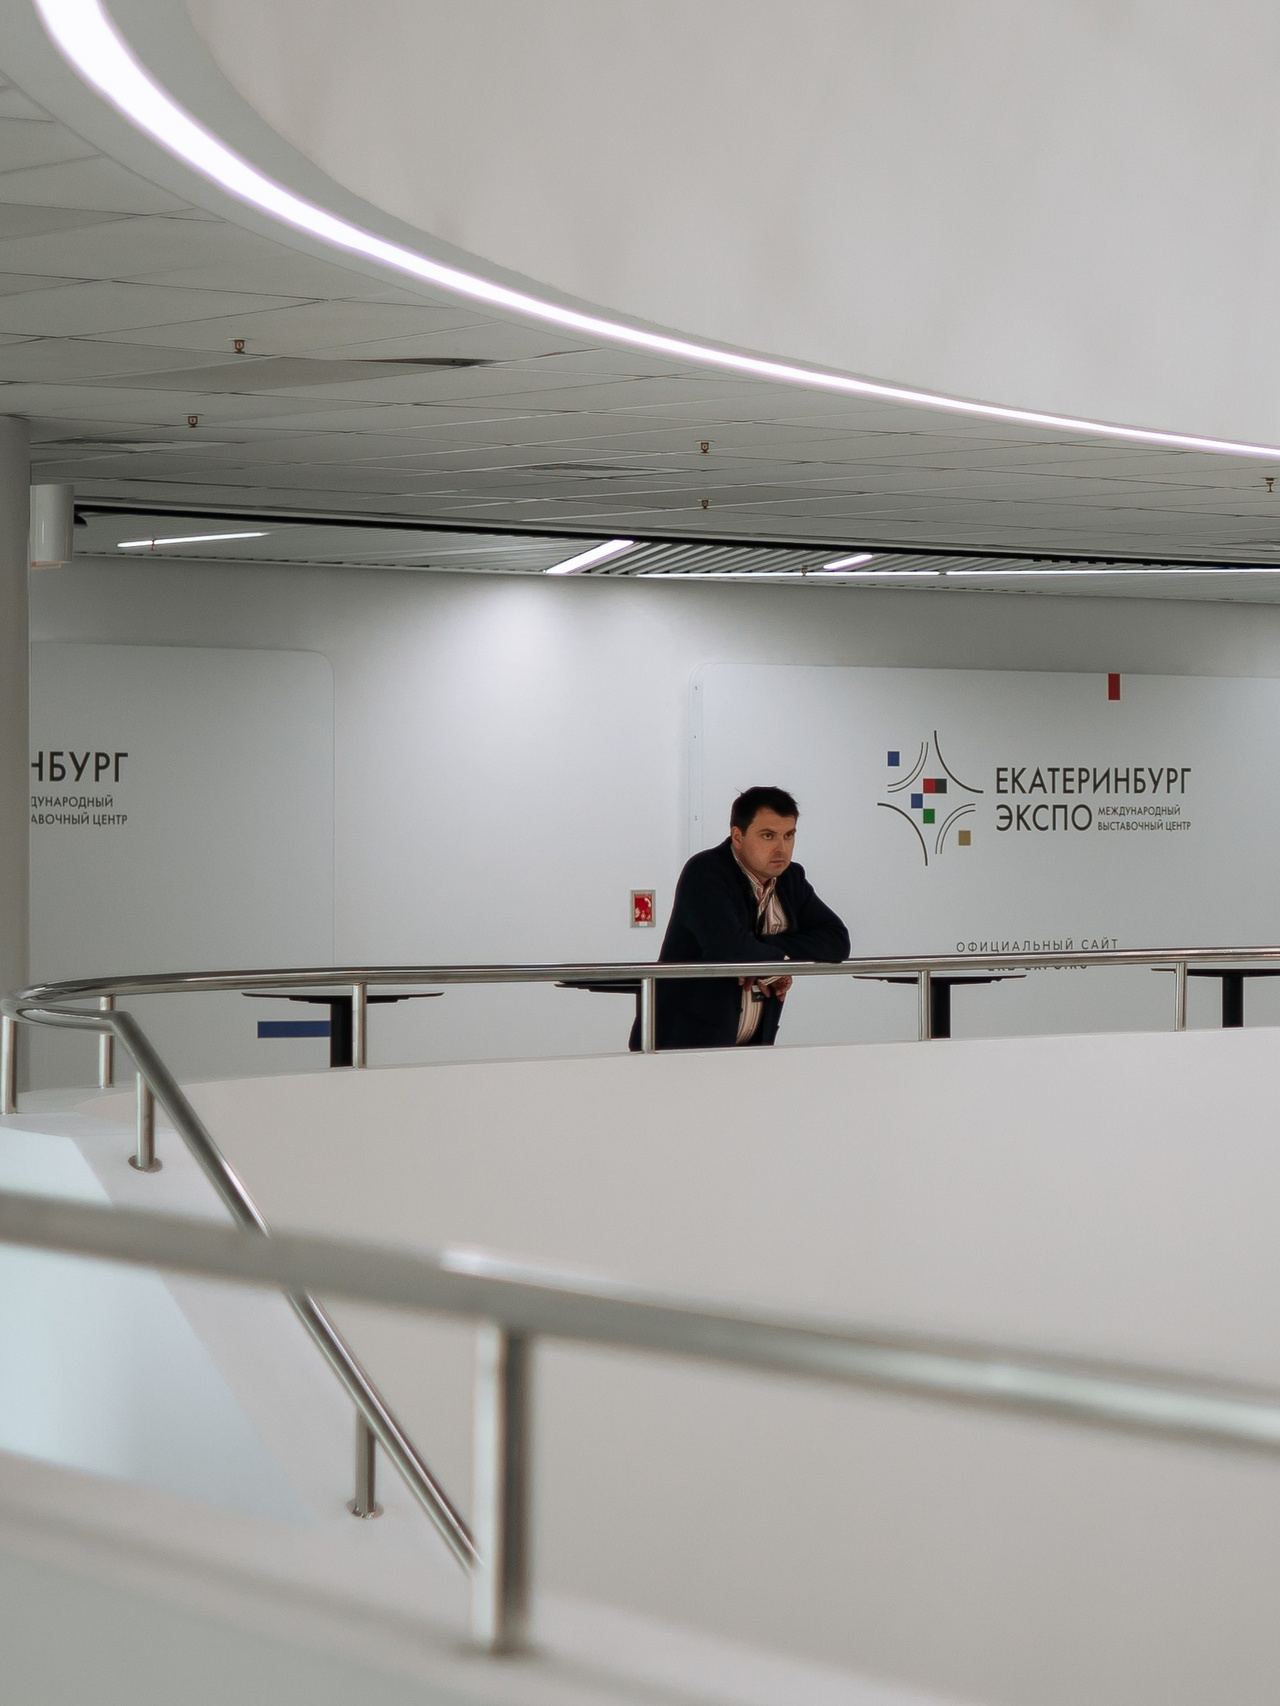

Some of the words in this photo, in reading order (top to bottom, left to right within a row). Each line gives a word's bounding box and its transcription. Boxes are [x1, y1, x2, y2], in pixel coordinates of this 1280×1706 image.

[996, 766, 1192, 795] ЕКАТЕРИНБУРГ
[996, 803, 1093, 832] ЭКСПО
[1097, 804, 1181, 817] МЕЖДУНАРОДНЫЙ
[92, 814, 128, 827] ЦЕНТР
[1097, 819, 1164, 832] ВЫСТАВОЧНЫЙ
[1165, 821, 1192, 833] ЦЕНТР
[956, 938, 1074, 953] ОФИЦИАЛЬНЫЙ
[1081, 936, 1119, 950] САЙТ
